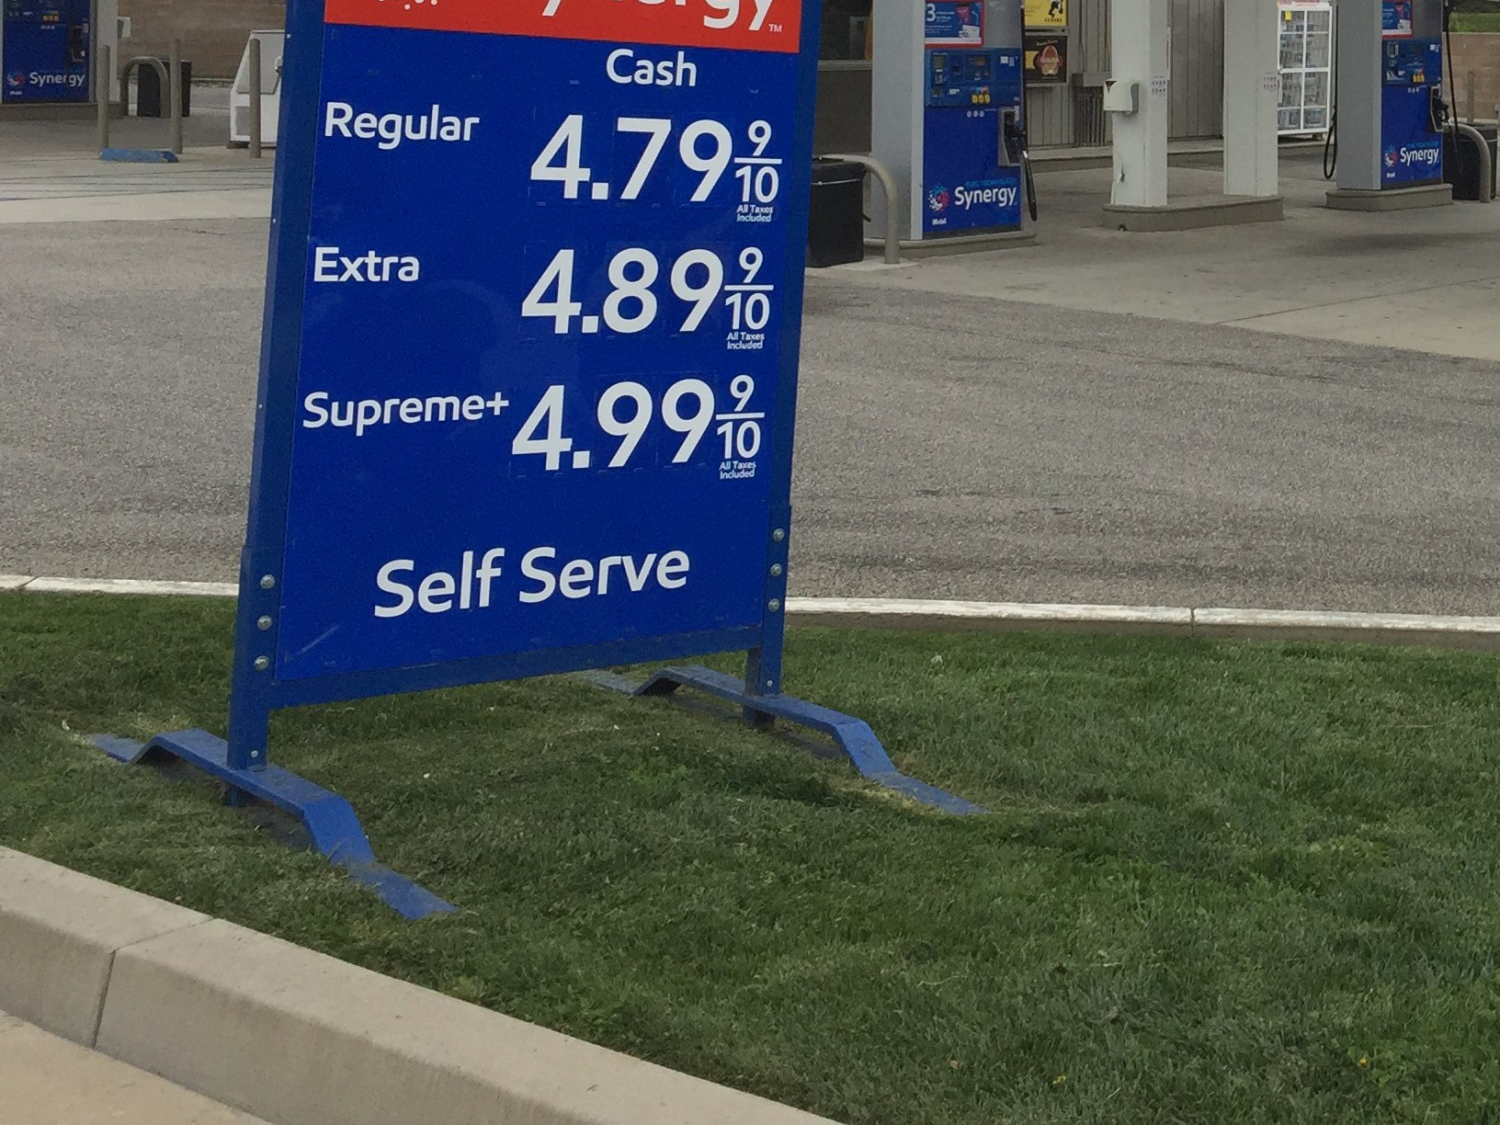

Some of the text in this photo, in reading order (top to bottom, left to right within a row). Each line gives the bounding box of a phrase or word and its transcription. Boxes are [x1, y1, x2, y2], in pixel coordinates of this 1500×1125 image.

[29, 71, 85, 88] Synergy
[606, 48, 697, 87] Cash
[324, 101, 772, 202] Regular 4.79 9
[1400, 147, 1440, 167] Synergy
[735, 165, 779, 203] 10
[954, 186, 1018, 211] Synergy
[313, 246, 764, 334] Extra 4.89 9
[725, 292, 770, 330] 10
[303, 374, 755, 471] Supreme+ 4.99 9
[716, 420, 761, 459] 10
[374, 546, 690, 618] Self Serve
